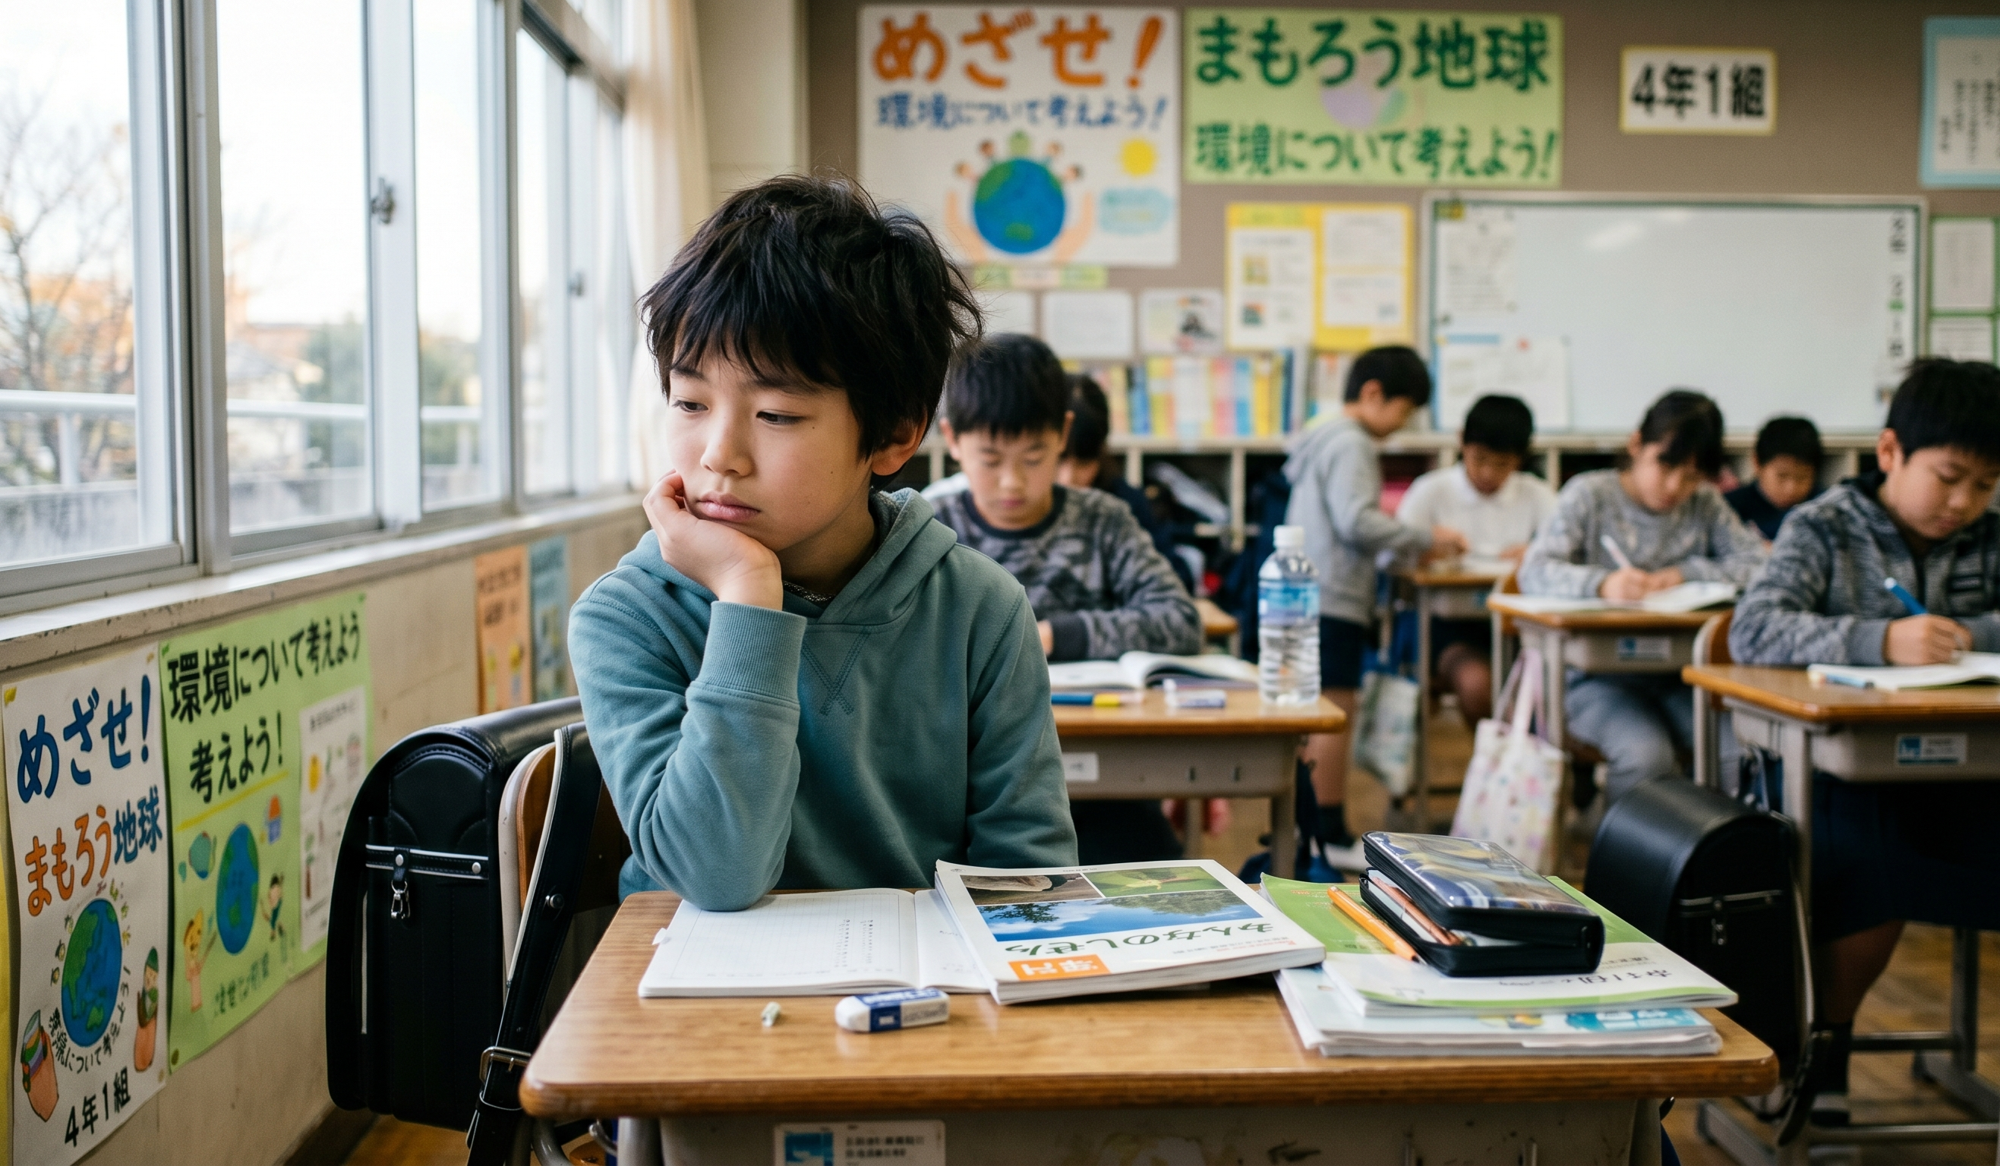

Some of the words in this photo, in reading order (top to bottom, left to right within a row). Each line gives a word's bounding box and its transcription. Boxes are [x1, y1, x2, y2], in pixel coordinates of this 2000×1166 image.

[872, 11, 1163, 90] めざせ！
[1195, 15, 1551, 92] まもろう地球
[1631, 61, 1766, 120] 4年1組
[1195, 122, 1557, 181] 環境について考えよう！
[166, 609, 362, 725] 環境について考えよう
[16, 673, 152, 804] めざせ！
[188, 709, 284, 804] 考えよう！
[24, 783, 163, 918] まもろう地球
[64, 1064, 132, 1149] 4年1組
